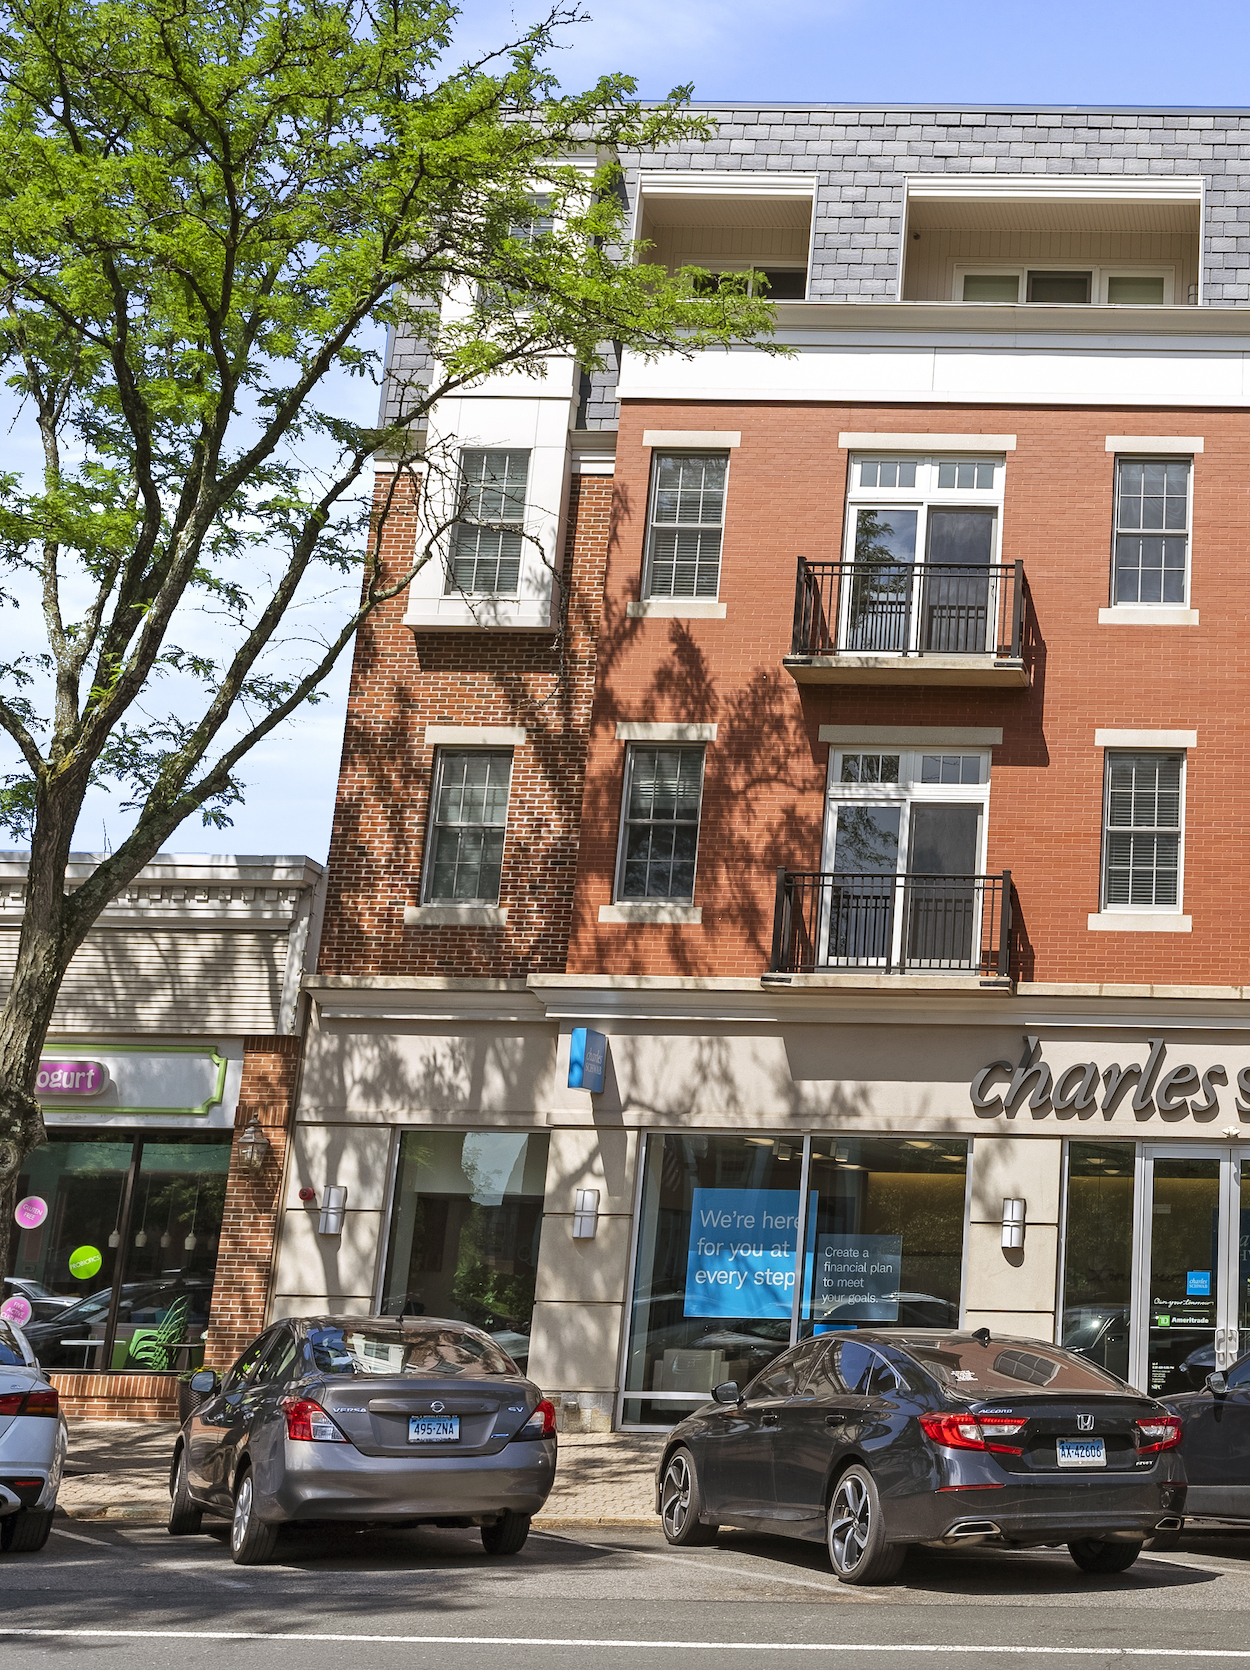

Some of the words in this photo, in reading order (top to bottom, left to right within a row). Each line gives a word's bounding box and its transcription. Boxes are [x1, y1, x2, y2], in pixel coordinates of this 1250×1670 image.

[37, 1069, 94, 1089] ogurt
[969, 1035, 1226, 1118] charles
[23, 1204, 43, 1216] GLUTEN
[24, 1212, 36, 1220] FREE
[700, 1210, 756, 1228] We're
[698, 1238, 722, 1256] for
[730, 1244, 764, 1262] you
[771, 1241, 790, 1258] at
[825, 1247, 860, 1258] Create
[70, 1255, 100, 1270] PROBIOTICS
[824, 1262, 867, 1272] financial
[870, 1264, 892, 1274] plan
[695, 1270, 748, 1290] every
[754, 1270, 795, 1290] step
[823, 1278, 834, 1287] to
[837, 1278, 864, 1288] meet
[822, 1294, 845, 1304] your
[848, 1293, 878, 1304] goals.
[6, 1306, 24, 1318] ACTIVE
[14, 1302, 24, 1310] FIVE
